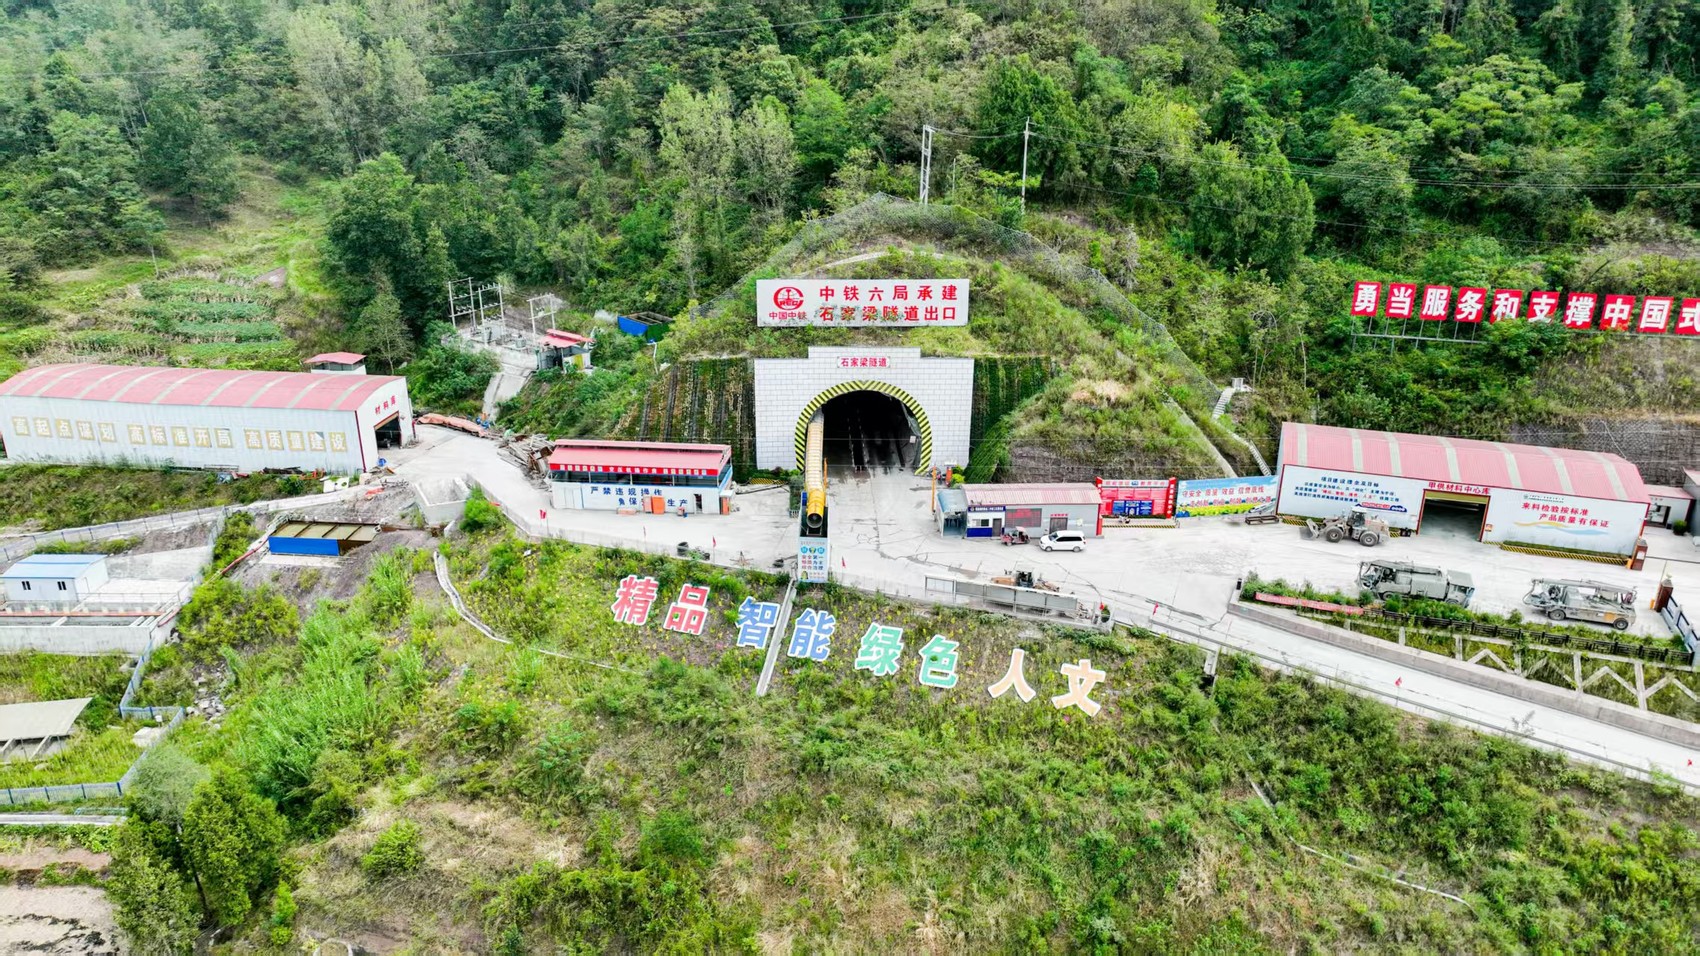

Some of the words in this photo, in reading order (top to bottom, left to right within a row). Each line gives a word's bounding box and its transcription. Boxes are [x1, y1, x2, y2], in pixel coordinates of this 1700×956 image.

[820, 285, 958, 301] 中铁六局承建
[769, 311, 808, 320] 中国中铁
[820, 305, 957, 322] 石家梁隧道出口
[1354, 284, 1700, 334] 勇当服务和支撑中国式
[841, 357, 888, 367] 石家梁隧道
[128, 425, 233, 447] 高标准开局
[245, 430, 347, 451] 高质量建设
[590, 486, 663, 497] 严禁违规操作
[618, 497, 688, 507] 确保生产
[1522, 502, 1589, 516] 来料检验按标准
[1539, 513, 1609, 527] 产品质量有保证
[611, 574, 711, 636] 精品
[735, 596, 836, 662] 智能
[855, 622, 961, 689] 绿色
[987, 647, 1107, 718] 人文
